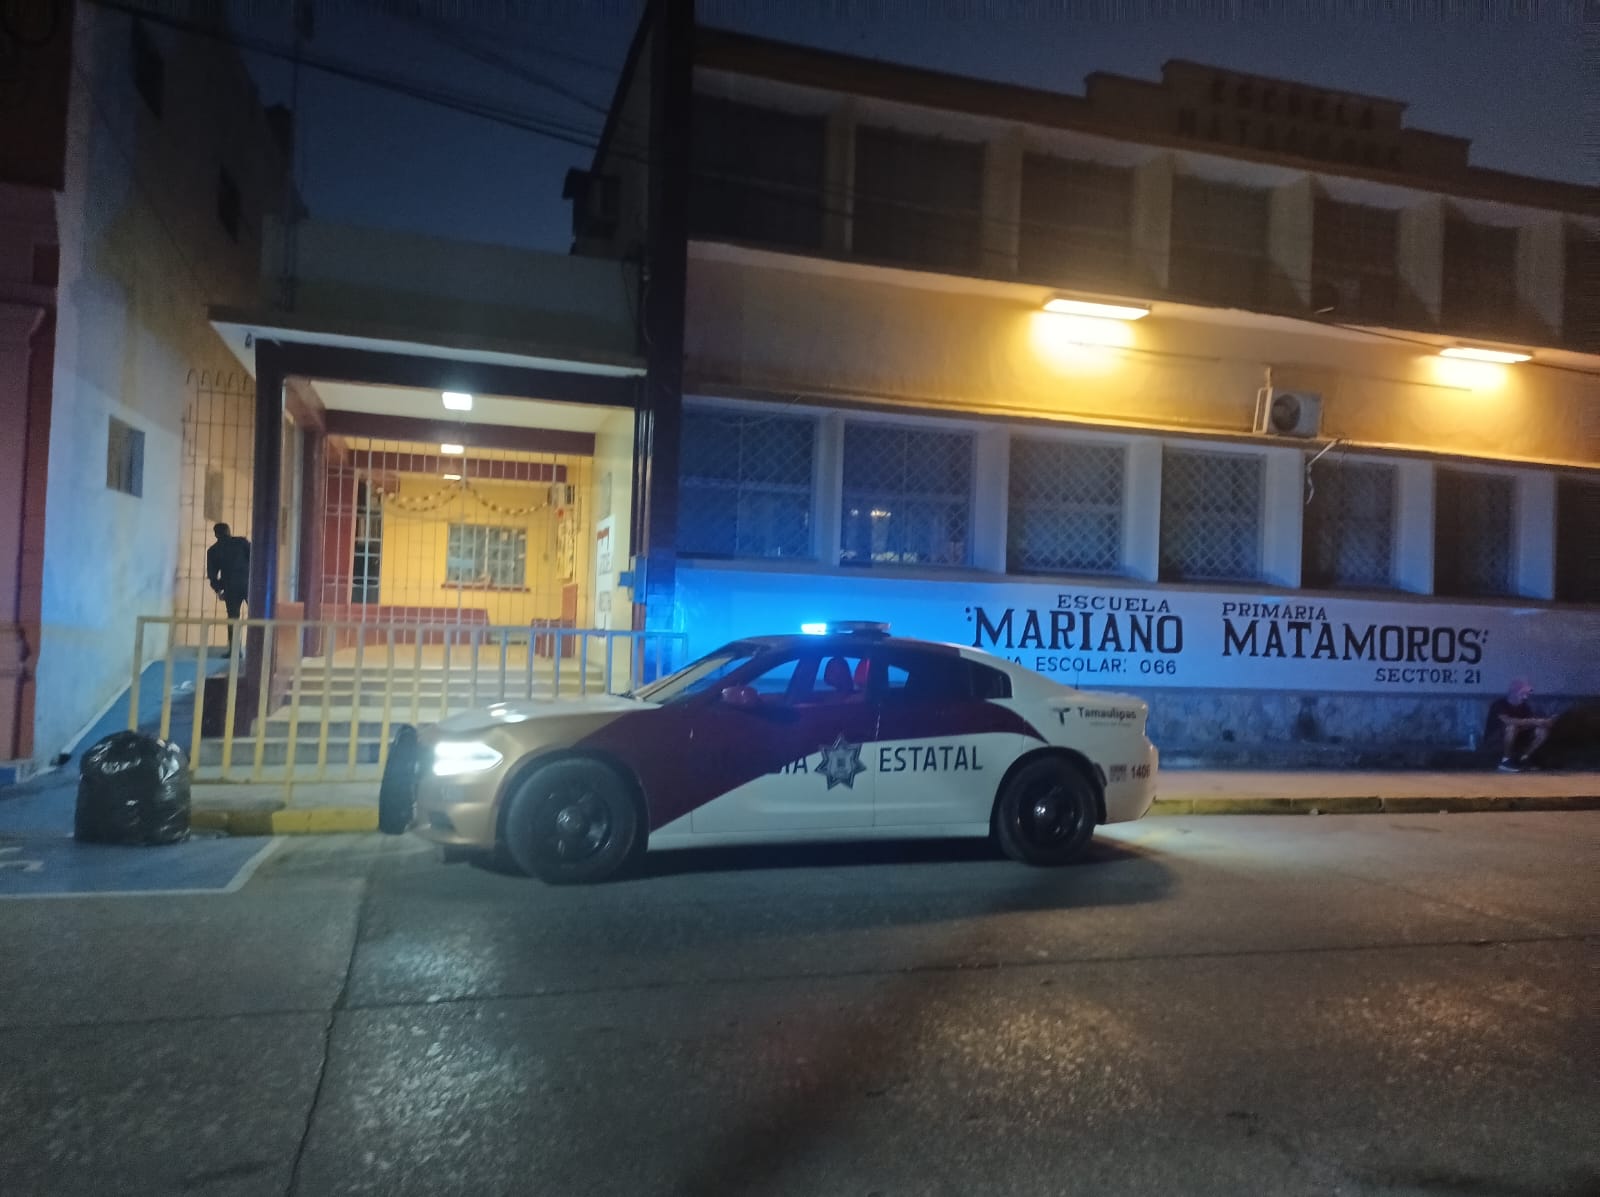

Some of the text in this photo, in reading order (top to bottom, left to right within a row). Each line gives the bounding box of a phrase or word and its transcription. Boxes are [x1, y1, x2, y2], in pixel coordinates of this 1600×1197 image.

[1057, 594, 1327, 620] ESCUELA PRIMARIA
[1140, 659, 1177, 675] 066
[1464, 669, 1481, 684] 21
[1077, 706, 1137, 720] Tamaulipas
[879, 745, 984, 772] ESTATAL
